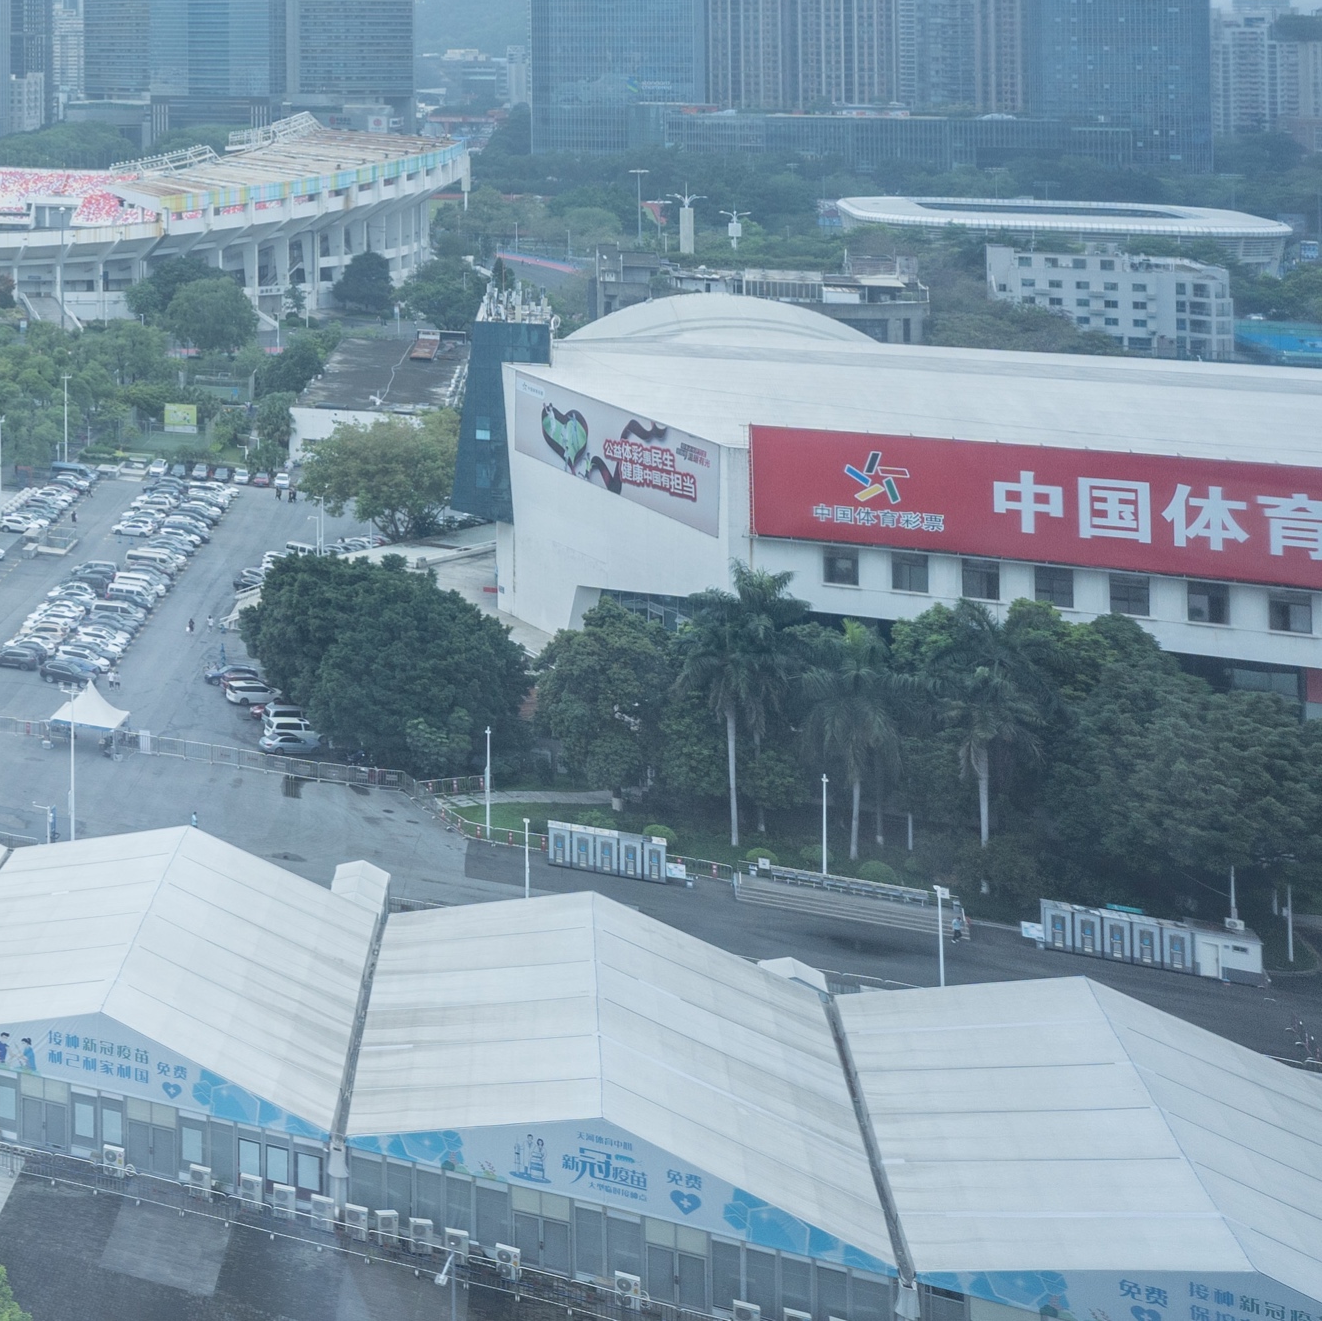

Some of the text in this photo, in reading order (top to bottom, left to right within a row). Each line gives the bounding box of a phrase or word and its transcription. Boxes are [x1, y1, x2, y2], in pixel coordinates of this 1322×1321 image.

[604, 442, 674, 471] 公益体彩惠民生
[621, 463, 696, 498] 健康中国有担当
[813, 503, 945, 533] 中国体育彩票
[993, 470, 1322, 561] 中国体育
[48, 1030, 150, 1065] 接种新冠疫苗
[48, 1049, 149, 1084] 利己利家利国
[157, 1061, 188, 1081] 免费
[561, 1146, 648, 1191] 新冠疫苗
[666, 1168, 703, 1191] 免费
[1119, 1278, 1169, 1308] 免费
